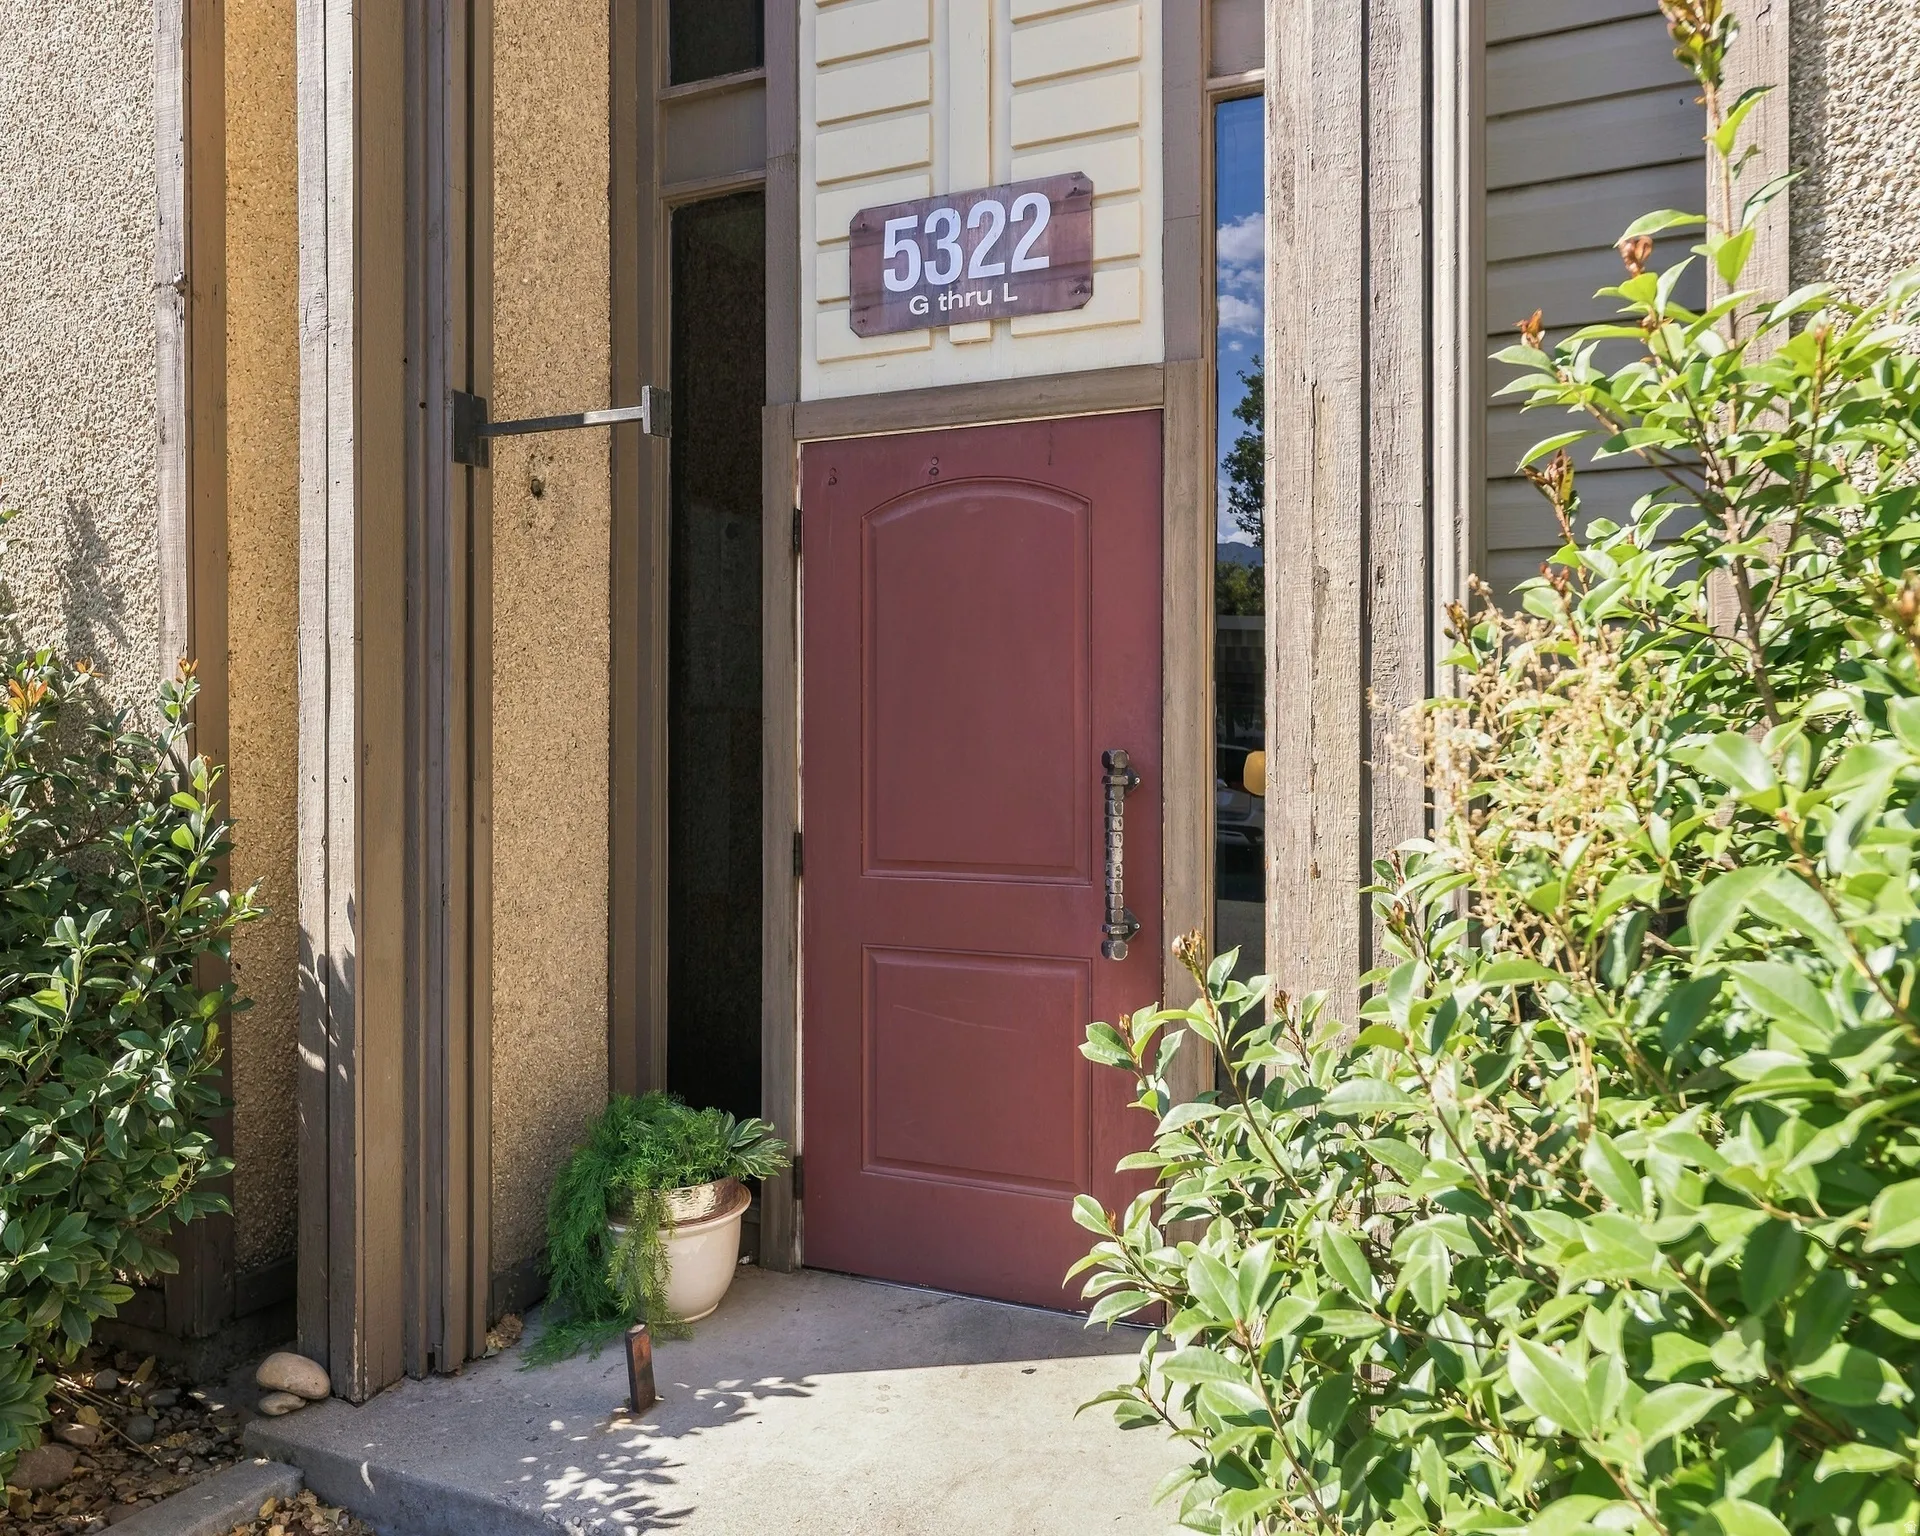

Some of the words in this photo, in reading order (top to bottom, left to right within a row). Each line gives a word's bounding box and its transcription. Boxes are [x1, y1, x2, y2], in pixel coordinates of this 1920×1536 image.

[883, 192, 1051, 292] 5322
[909, 295, 929, 315] G
[938, 289, 992, 312] thru
[1003, 282, 1018, 303] L
